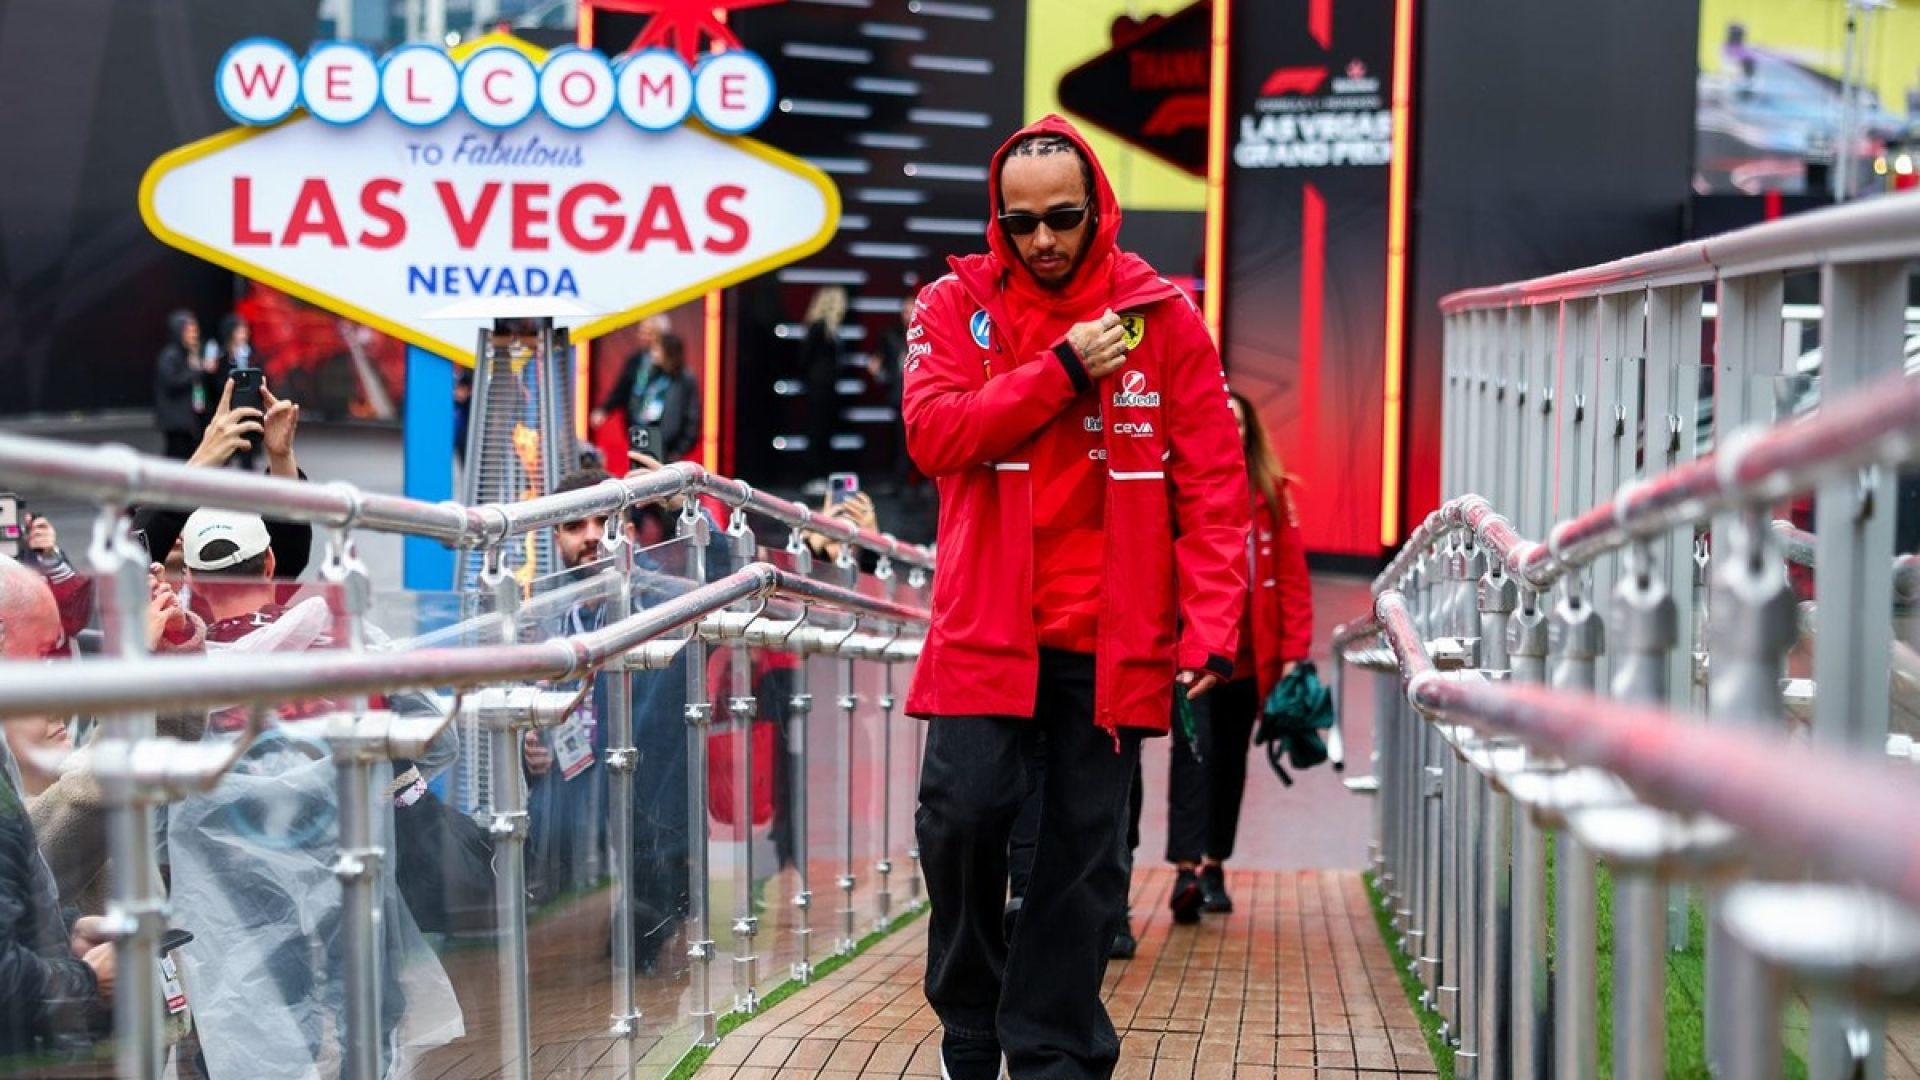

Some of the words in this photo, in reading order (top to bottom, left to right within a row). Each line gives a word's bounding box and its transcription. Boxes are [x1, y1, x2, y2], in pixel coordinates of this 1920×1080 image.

[235, 63, 746, 111] WELCOME
[408, 143, 443, 166] TO
[452, 132, 584, 168] Fabulous
[232, 176, 409, 251] LAS
[435, 180, 752, 256] VEGAS
[407, 264, 580, 297] NEVADA
